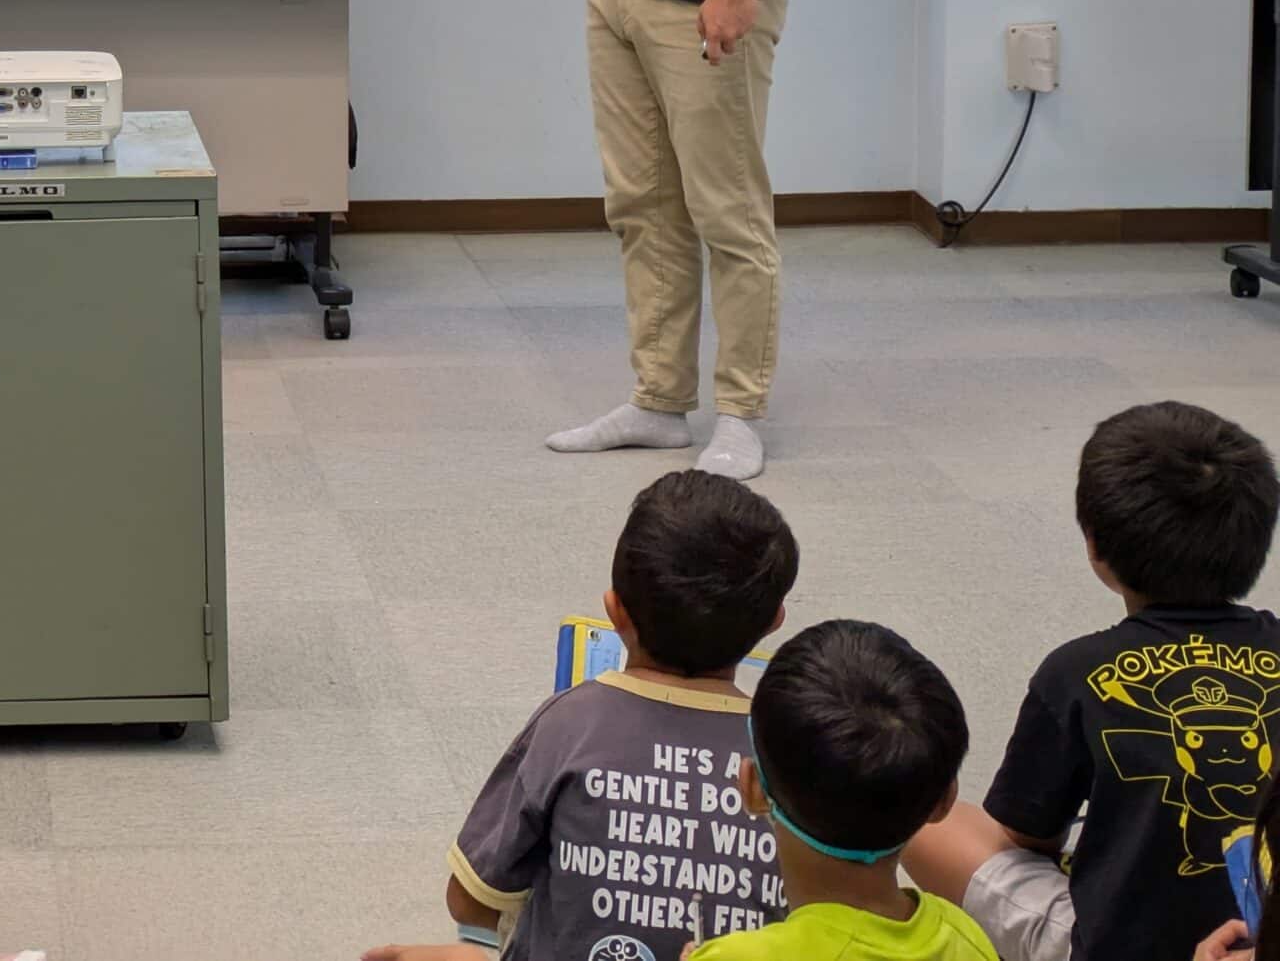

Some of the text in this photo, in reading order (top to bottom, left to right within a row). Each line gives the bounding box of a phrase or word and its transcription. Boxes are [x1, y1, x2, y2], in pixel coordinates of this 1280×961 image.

[653, 743, 742, 780] HE'S A
[585, 768, 754, 820] GENTLE BO
[607, 809, 777, 863] HEART WHO
[559, 840, 753, 899] UNDERSTANDS
[592, 888, 699, 933] OTHERS
